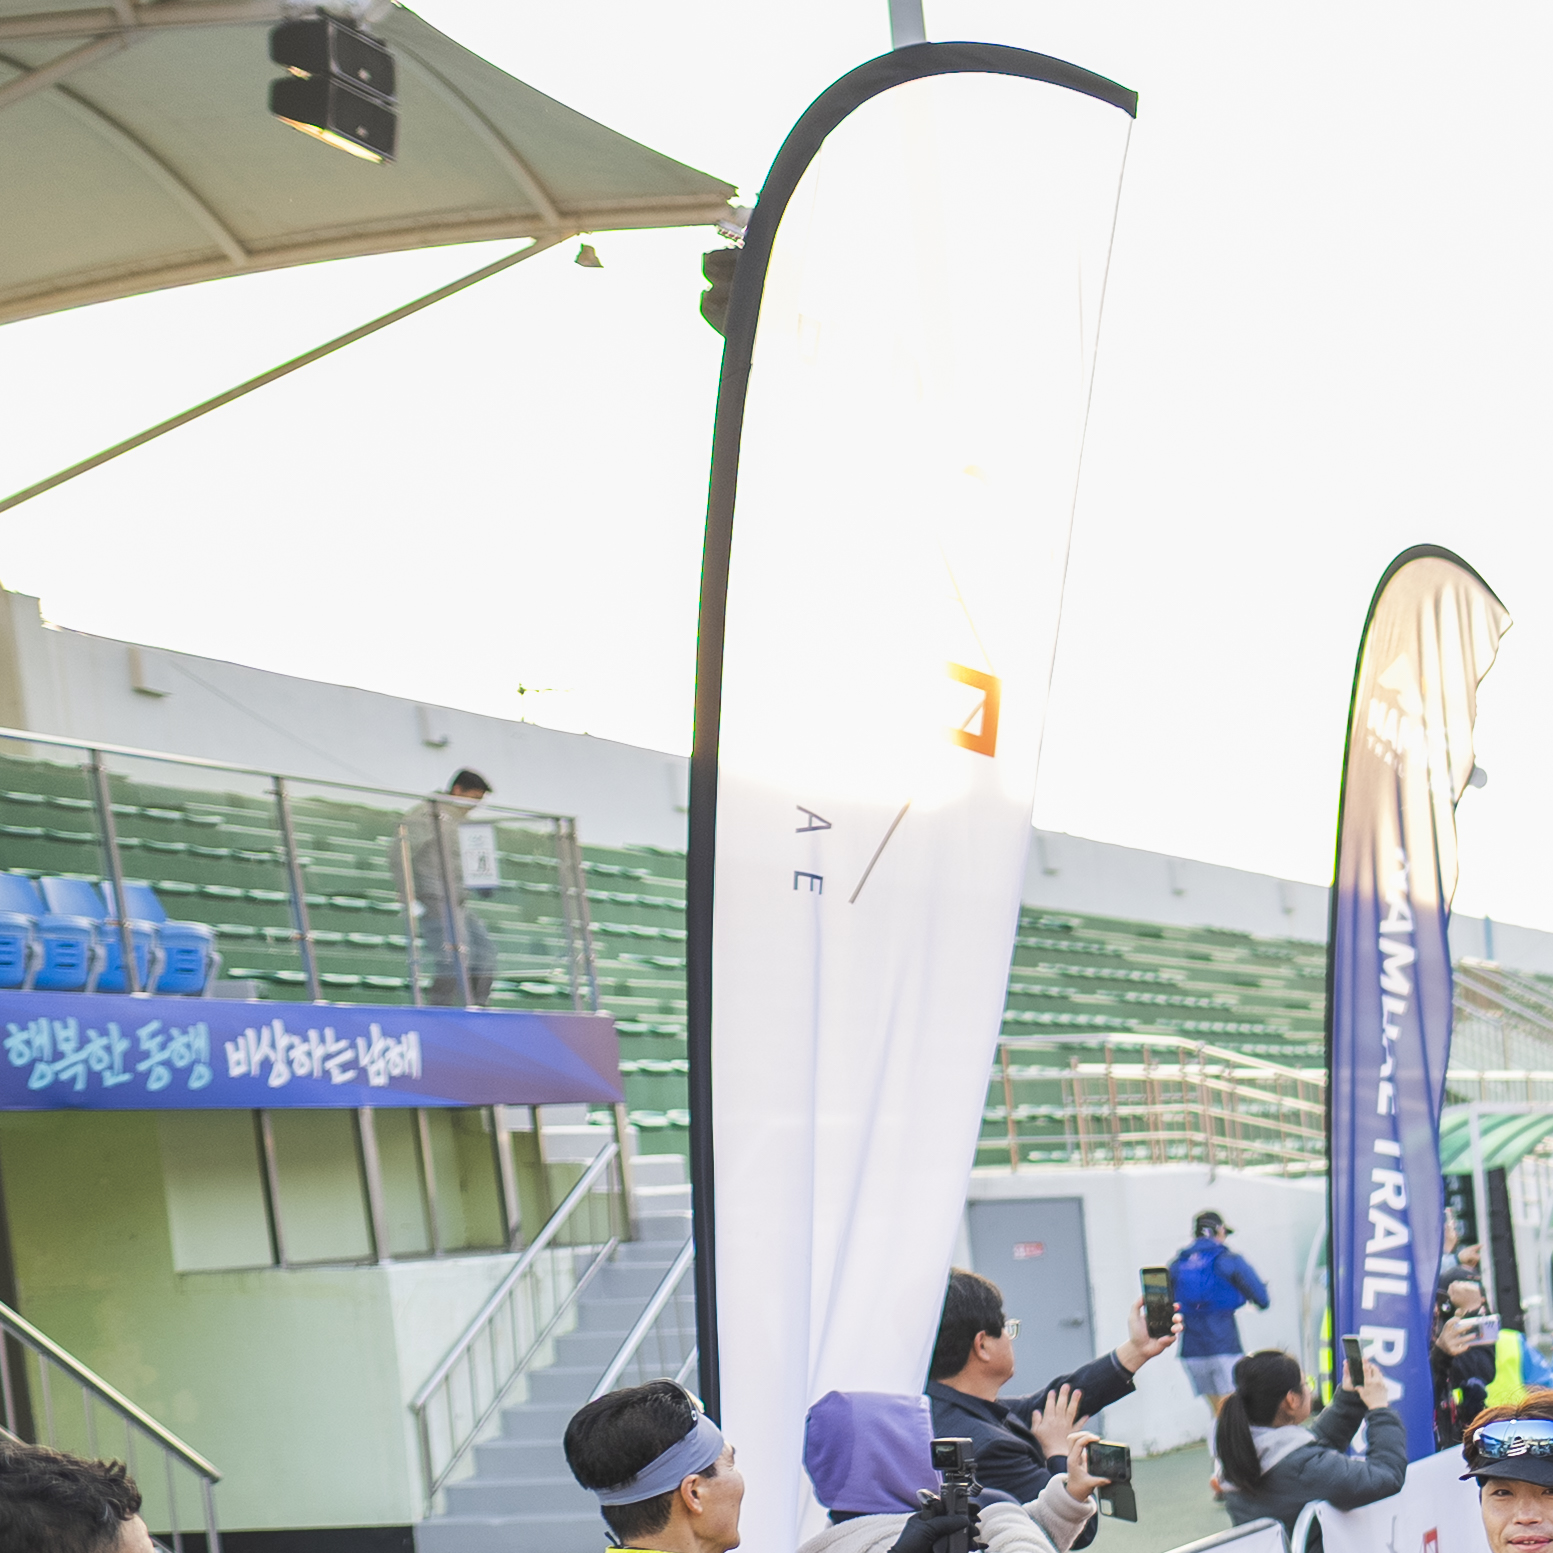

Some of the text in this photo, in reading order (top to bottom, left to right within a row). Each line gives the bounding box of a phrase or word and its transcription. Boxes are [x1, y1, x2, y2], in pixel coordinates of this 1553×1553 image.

[3, 1016, 423, 1091] 행복한 동행 비상하는 남해
